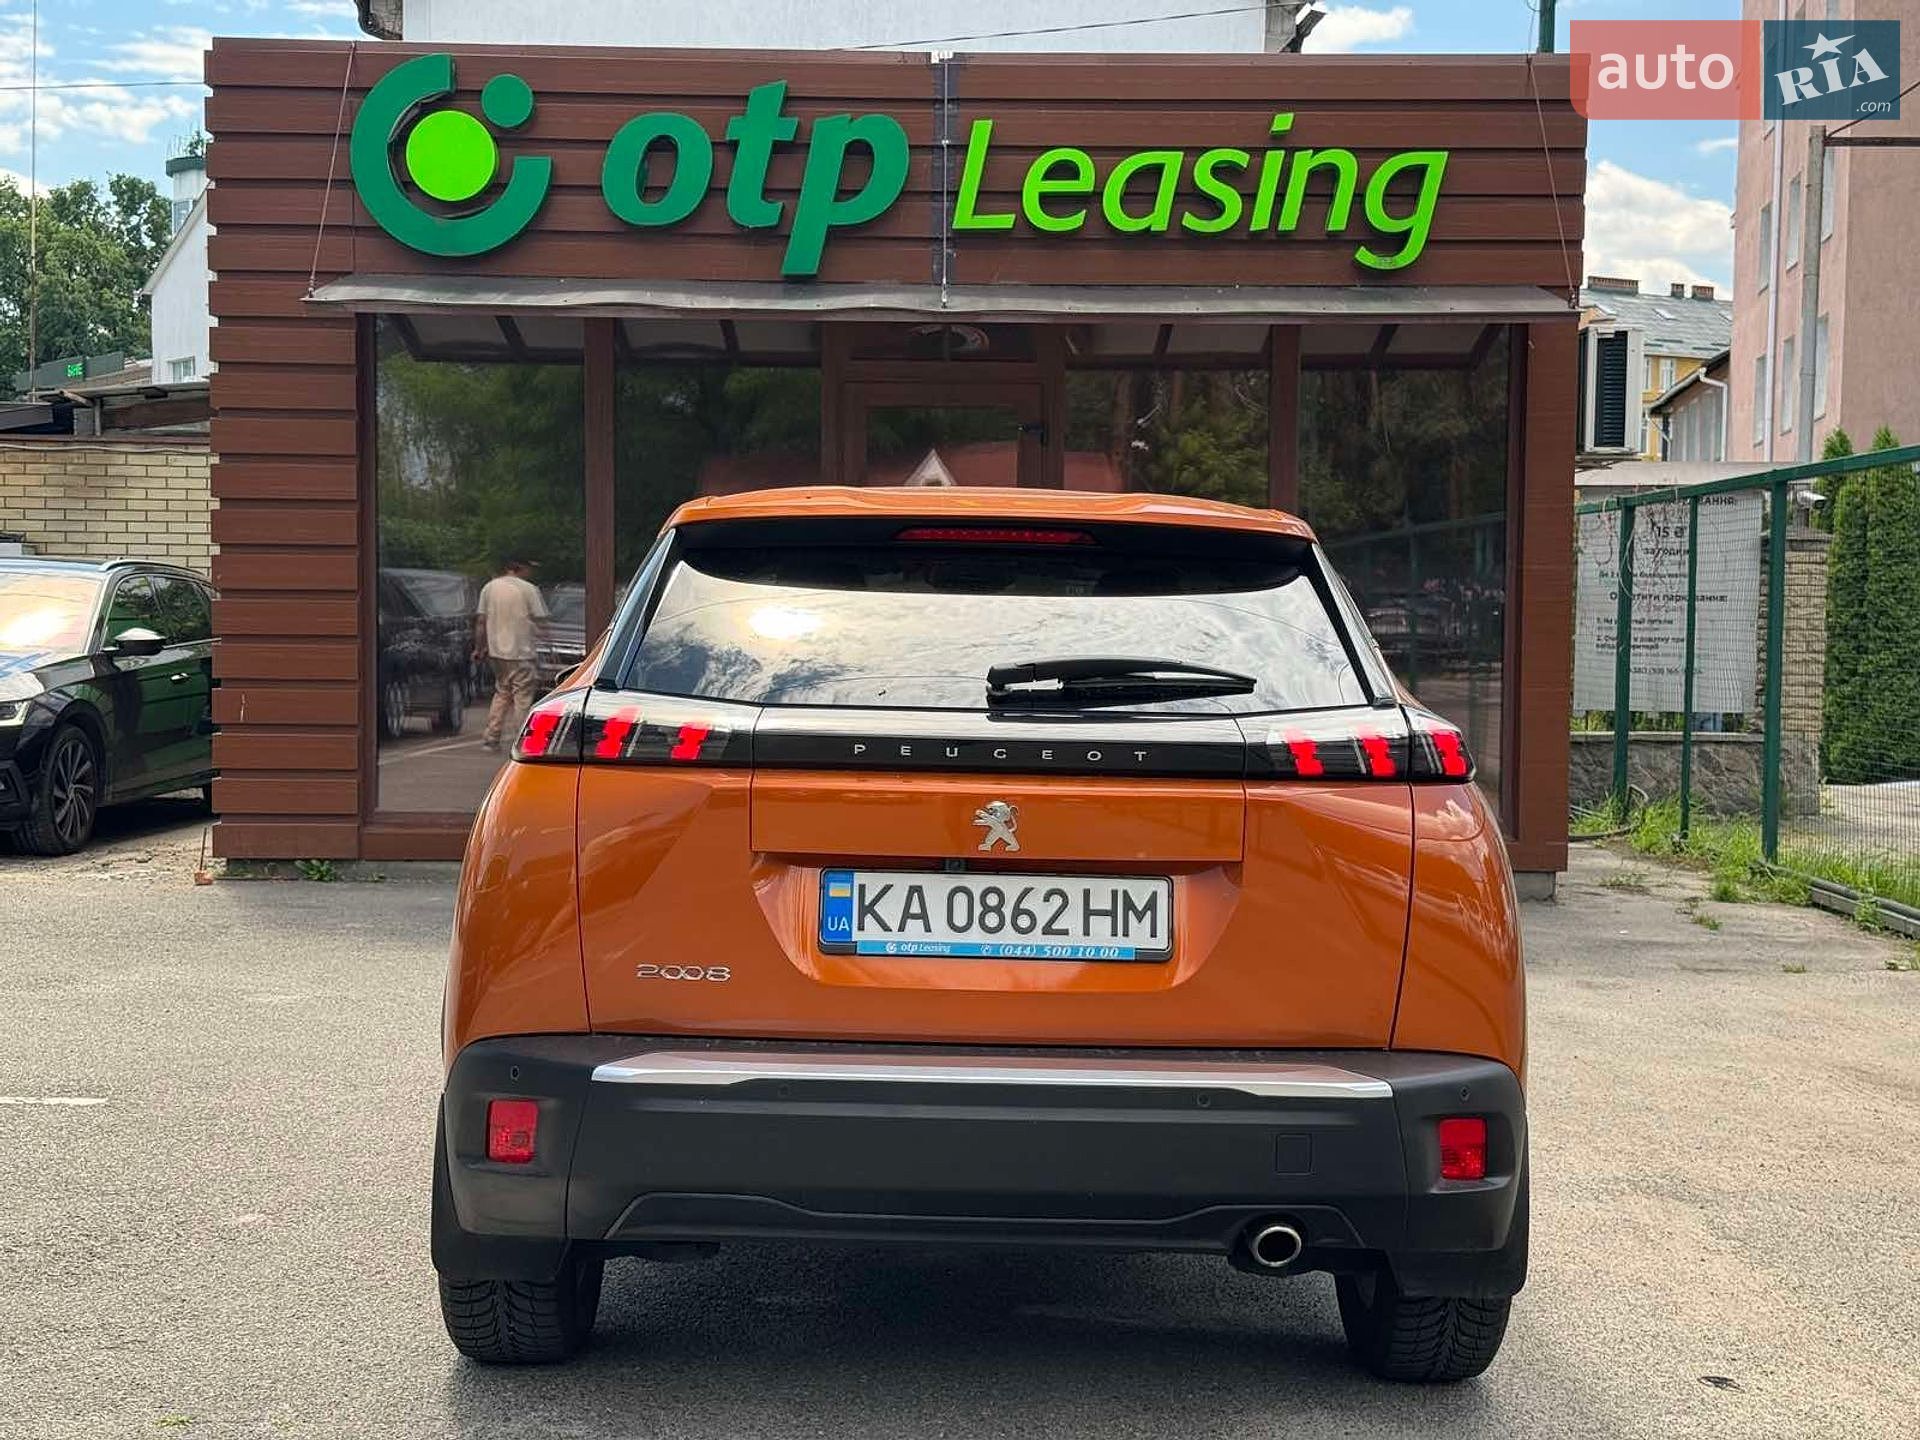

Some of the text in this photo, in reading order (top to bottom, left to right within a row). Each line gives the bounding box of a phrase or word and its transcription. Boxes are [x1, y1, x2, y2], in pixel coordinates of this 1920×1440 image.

[602, 80, 1450, 276] otp Leasing
[854, 744, 1147, 761] PEUGEOT
[857, 884, 1158, 938] KA 0862 HM
[828, 916, 850, 932] UA
[1000, 944, 1119, 959] (044) 500 10 00
[636, 963, 731, 982] 2008
